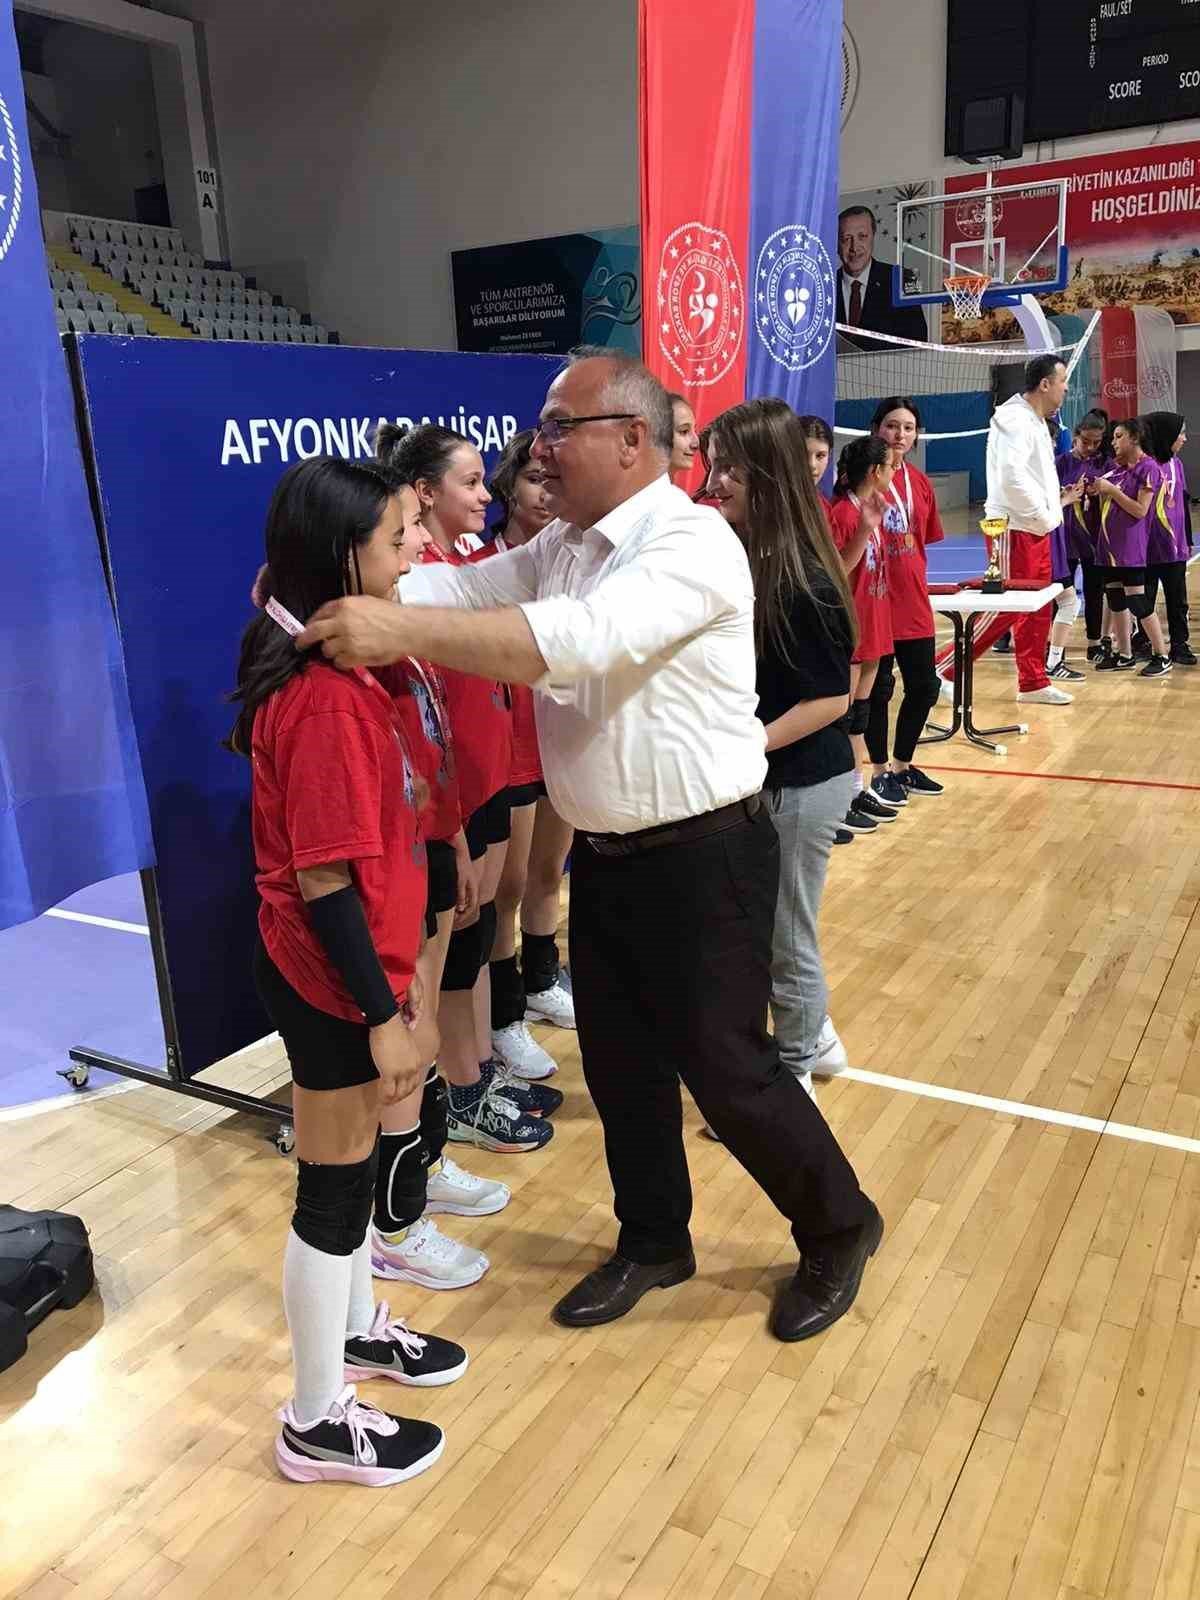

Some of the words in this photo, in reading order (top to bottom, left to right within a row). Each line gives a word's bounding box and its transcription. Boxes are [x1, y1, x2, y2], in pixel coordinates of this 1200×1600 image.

[1142, 53, 1169, 67] PERIOD
[1108, 80, 1142, 100] SCORE
[197, 170, 215, 185] 101
[1115, 157, 1195, 186] KAZANILDIĞI
[202, 192, 214, 209] A
[480, 288, 500, 302] TÜM
[503, 282, 554, 299] ANTRENÖR
[470, 304, 481, 315] VE
[483, 295, 566, 313] SPORCULARIMIZA
[473, 314, 517, 327] BAŞARILAR
[519, 308, 565, 321] DİLİYORUM
[221, 406, 518, 465] AFYONKİSAR
